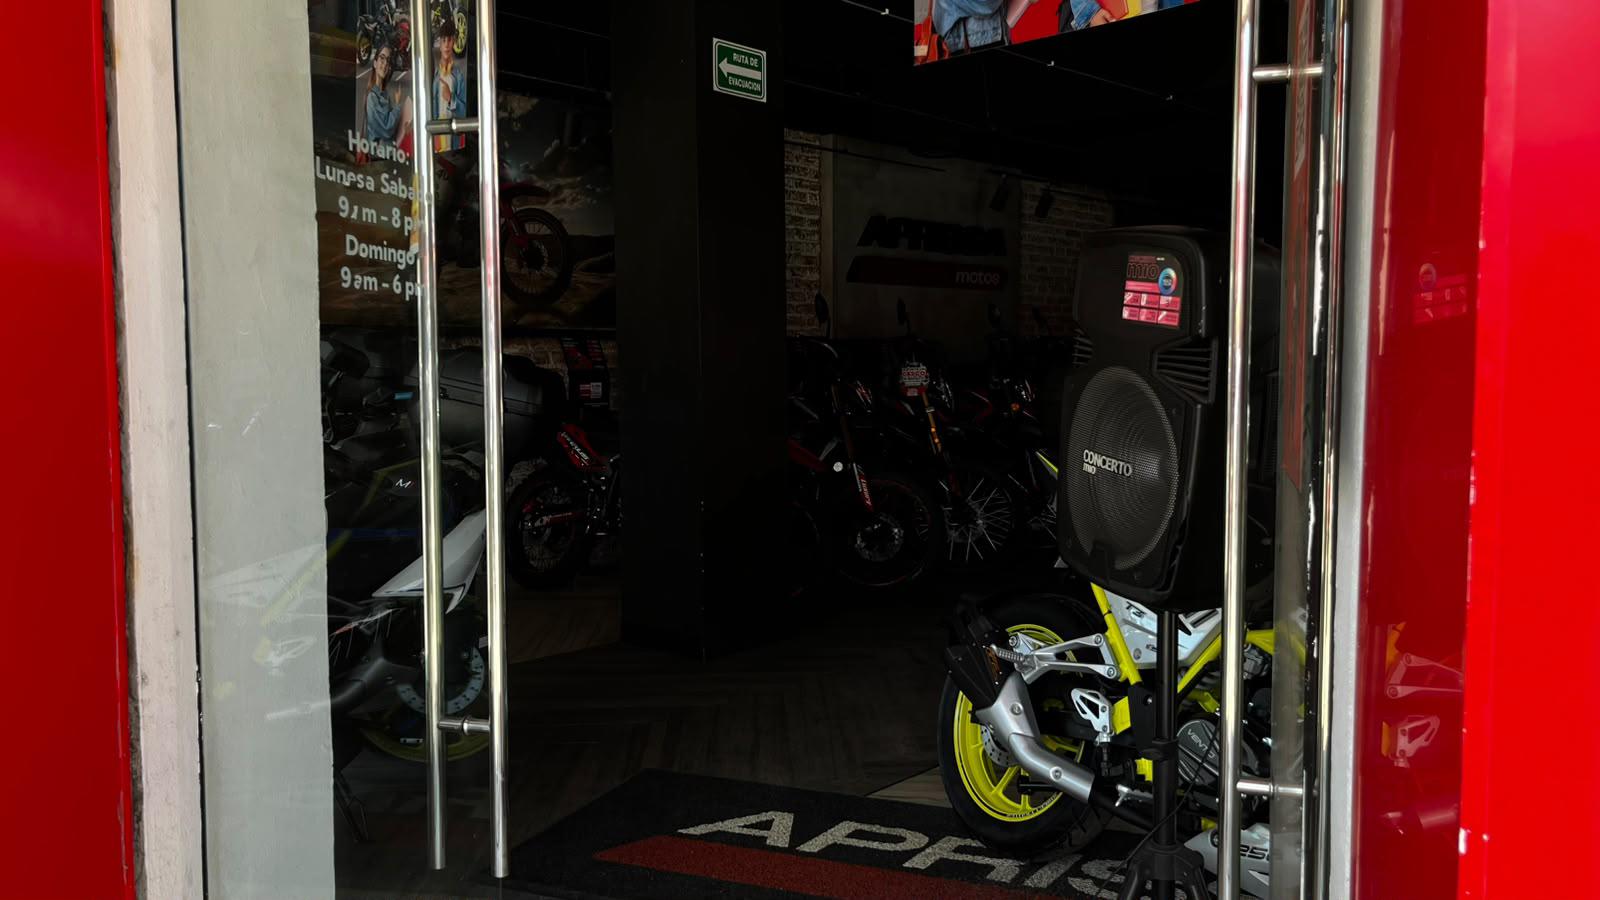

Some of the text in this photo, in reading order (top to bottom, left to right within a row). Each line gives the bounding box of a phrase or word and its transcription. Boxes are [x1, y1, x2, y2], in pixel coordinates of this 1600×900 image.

[732, 52, 759, 68] RUTA DE
[348, 129, 409, 165] Horario:
[345, 234, 416, 270] Domingo
[955, 271, 1001, 286] motos
[1083, 449, 1132, 477] CONCERTO
[1187, 728, 1216, 759] VENTO
